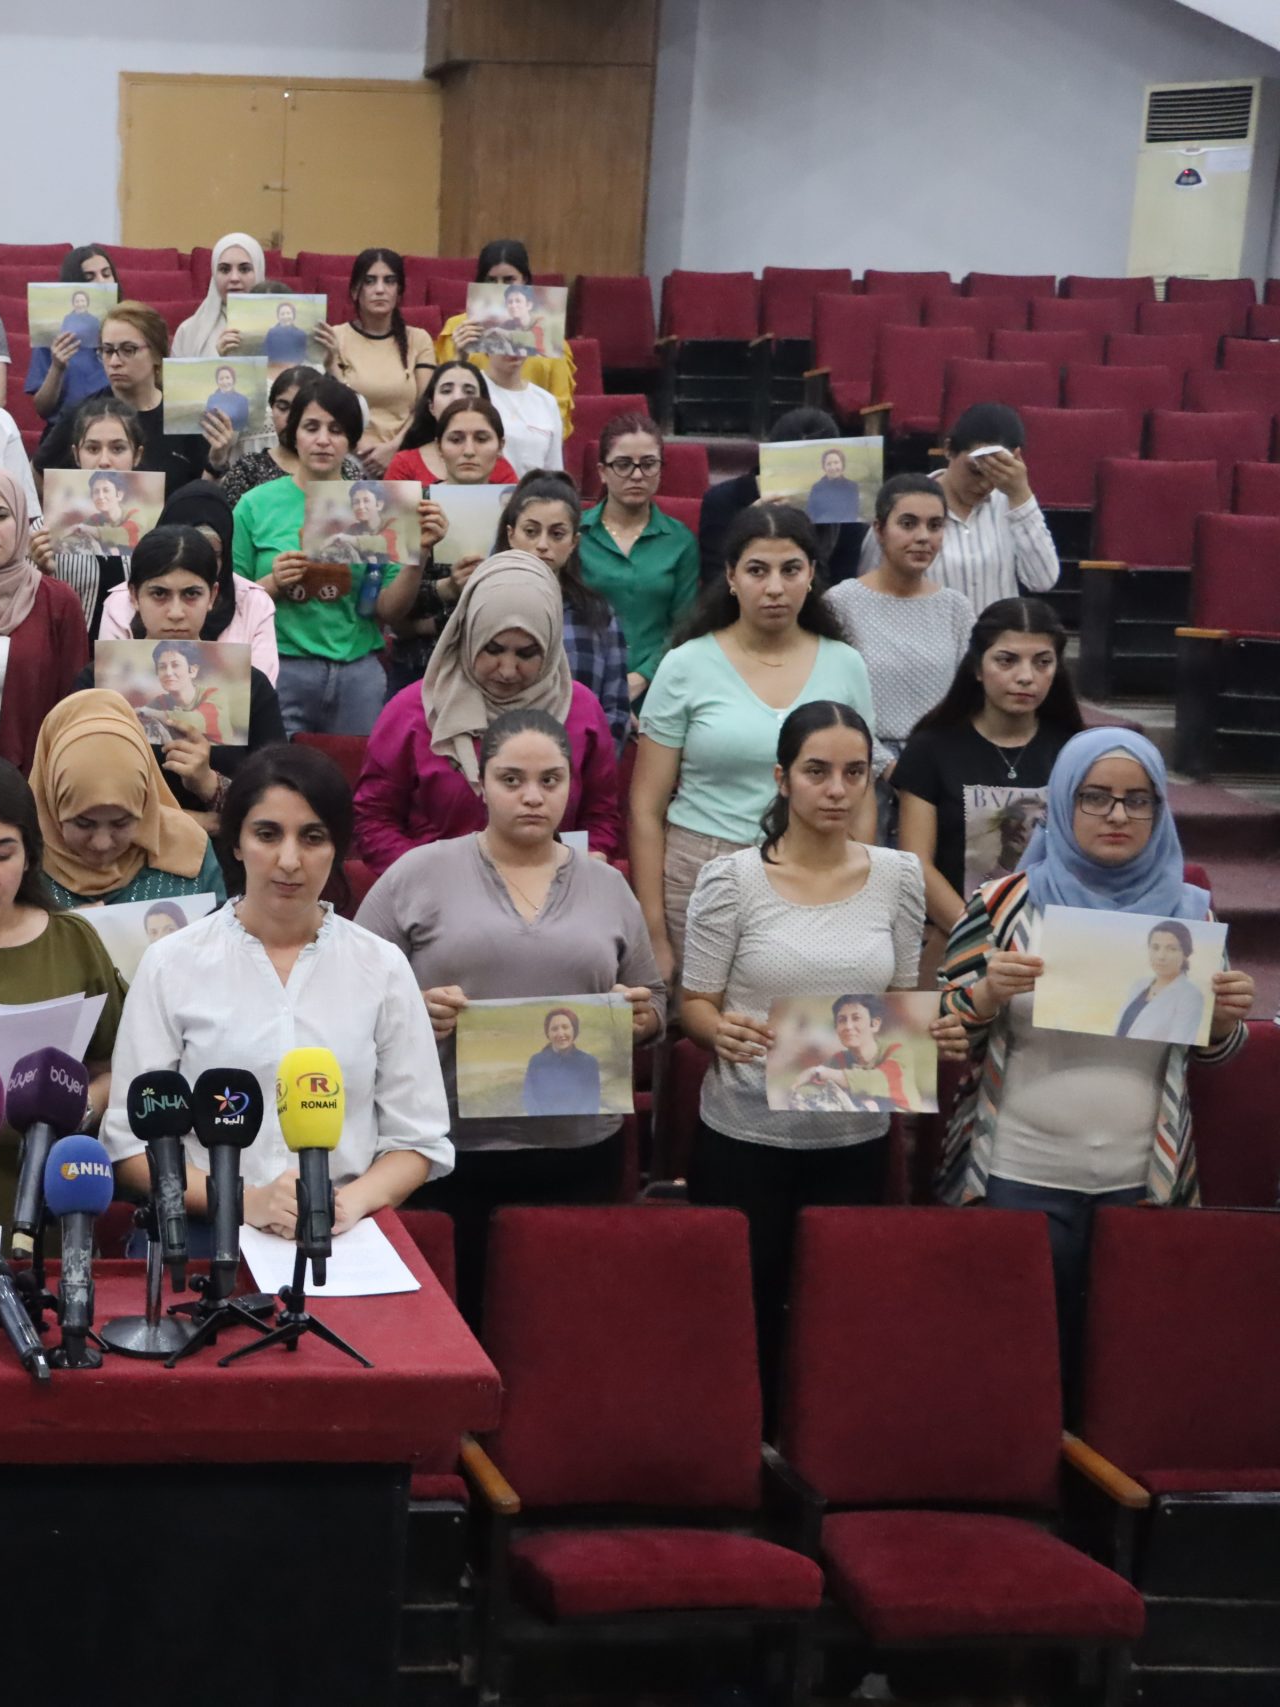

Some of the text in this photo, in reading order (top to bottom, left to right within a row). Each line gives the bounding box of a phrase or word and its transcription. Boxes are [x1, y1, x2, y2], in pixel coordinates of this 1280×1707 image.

[49, 1065, 84, 1096] bûyer
[310, 1077, 330, 1093] R
[215, 1115, 244, 1125] اليوم
[67, 1162, 111, 1178] ANHA
